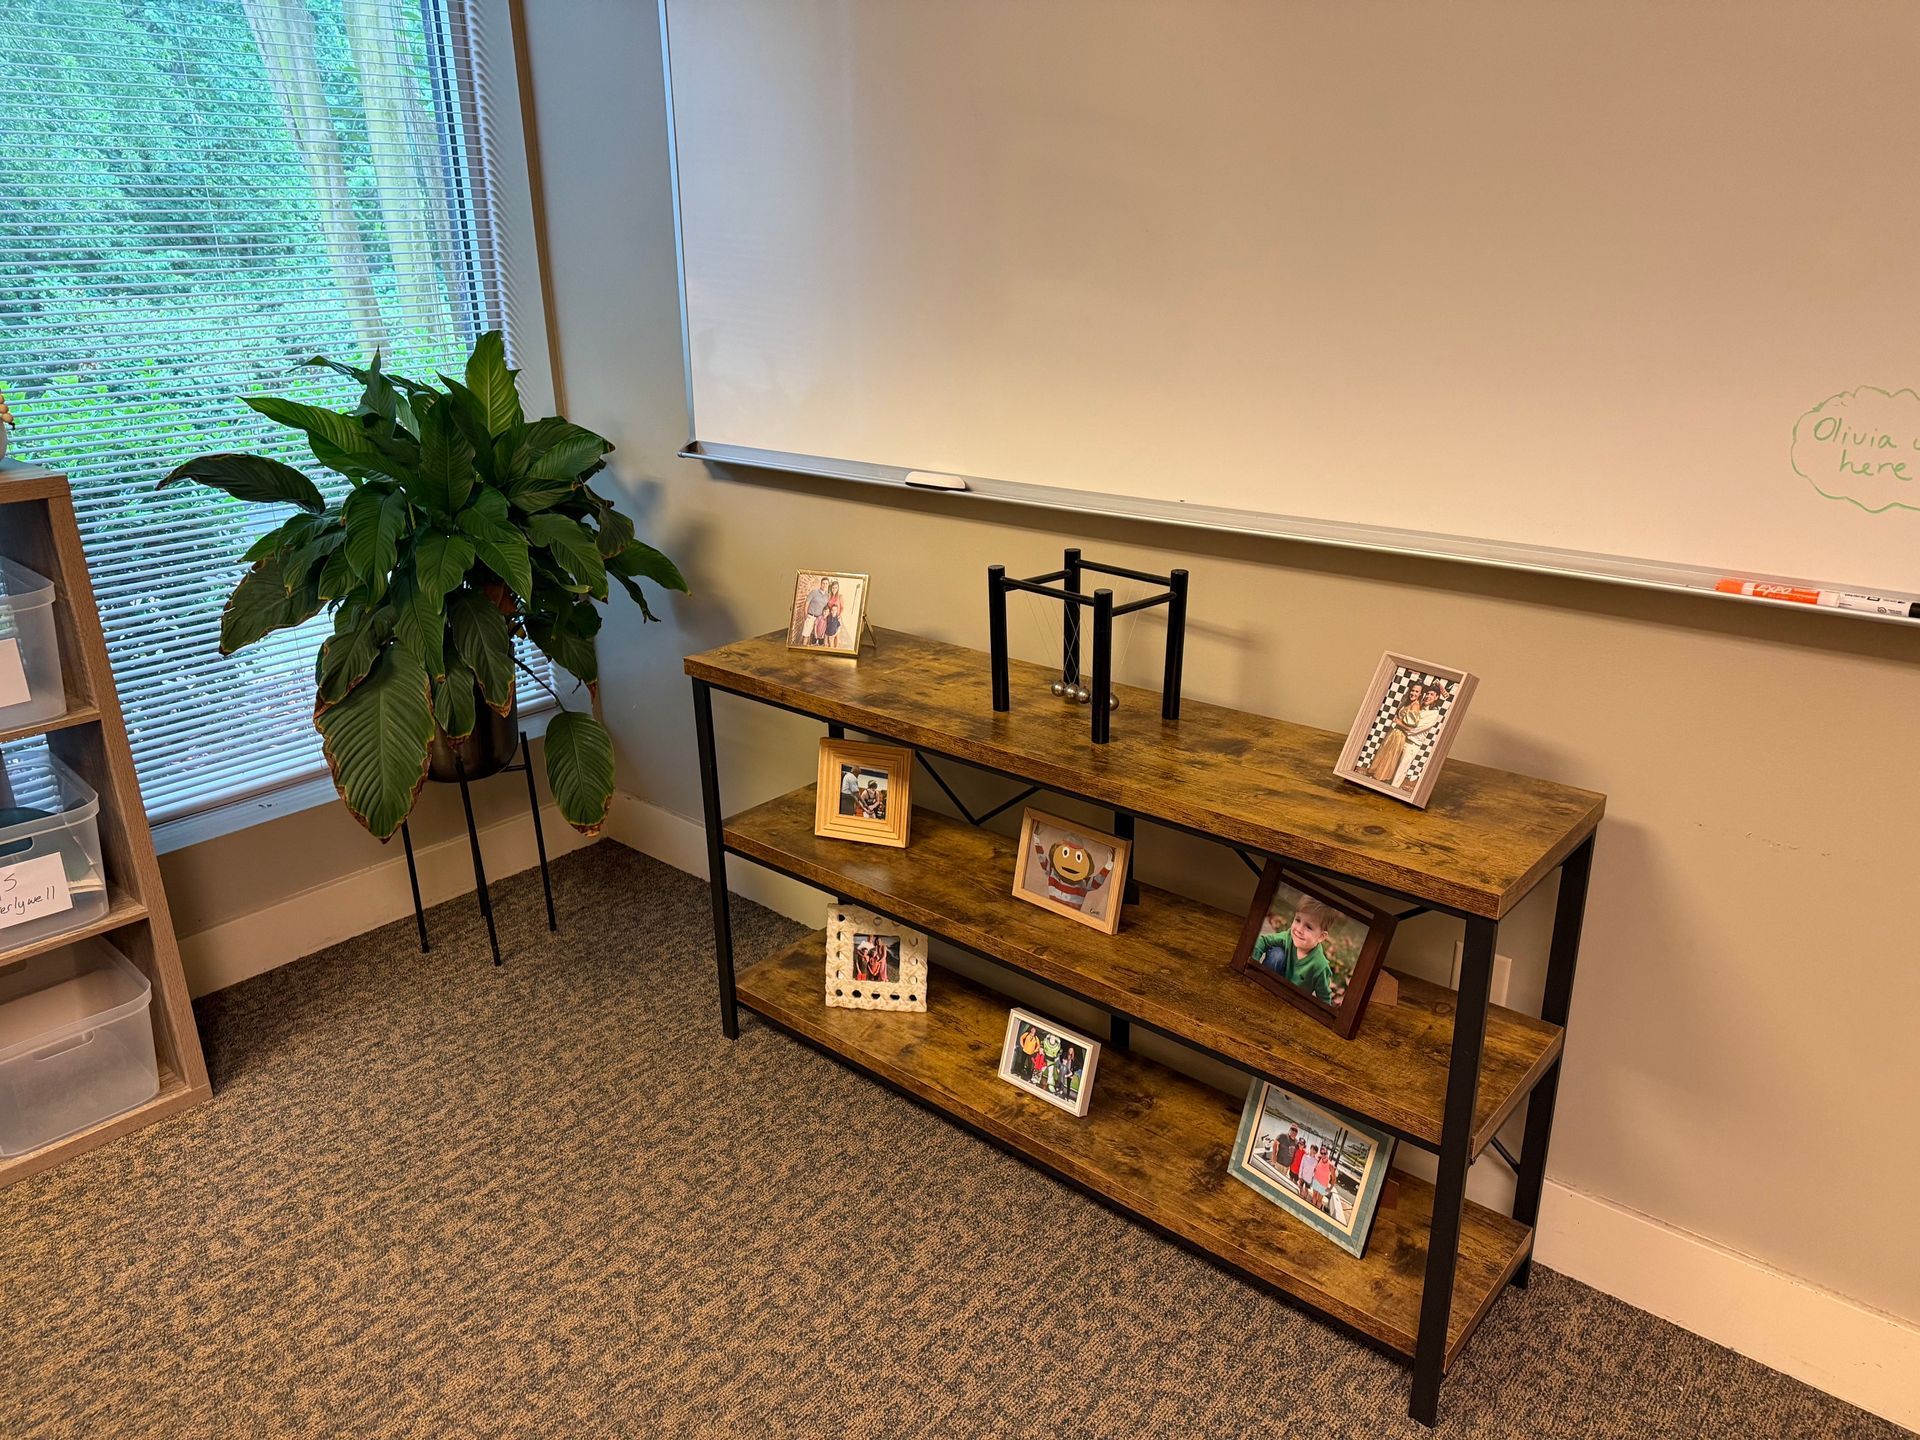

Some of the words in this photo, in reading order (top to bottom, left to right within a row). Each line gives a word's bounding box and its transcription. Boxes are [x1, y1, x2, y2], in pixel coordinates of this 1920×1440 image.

[1814, 417, 1897, 448] Olivia
[1840, 449, 1912, 481] here
[1756, 584, 1793, 596] EXPO
[0, 885, 55, 915] erlywell
